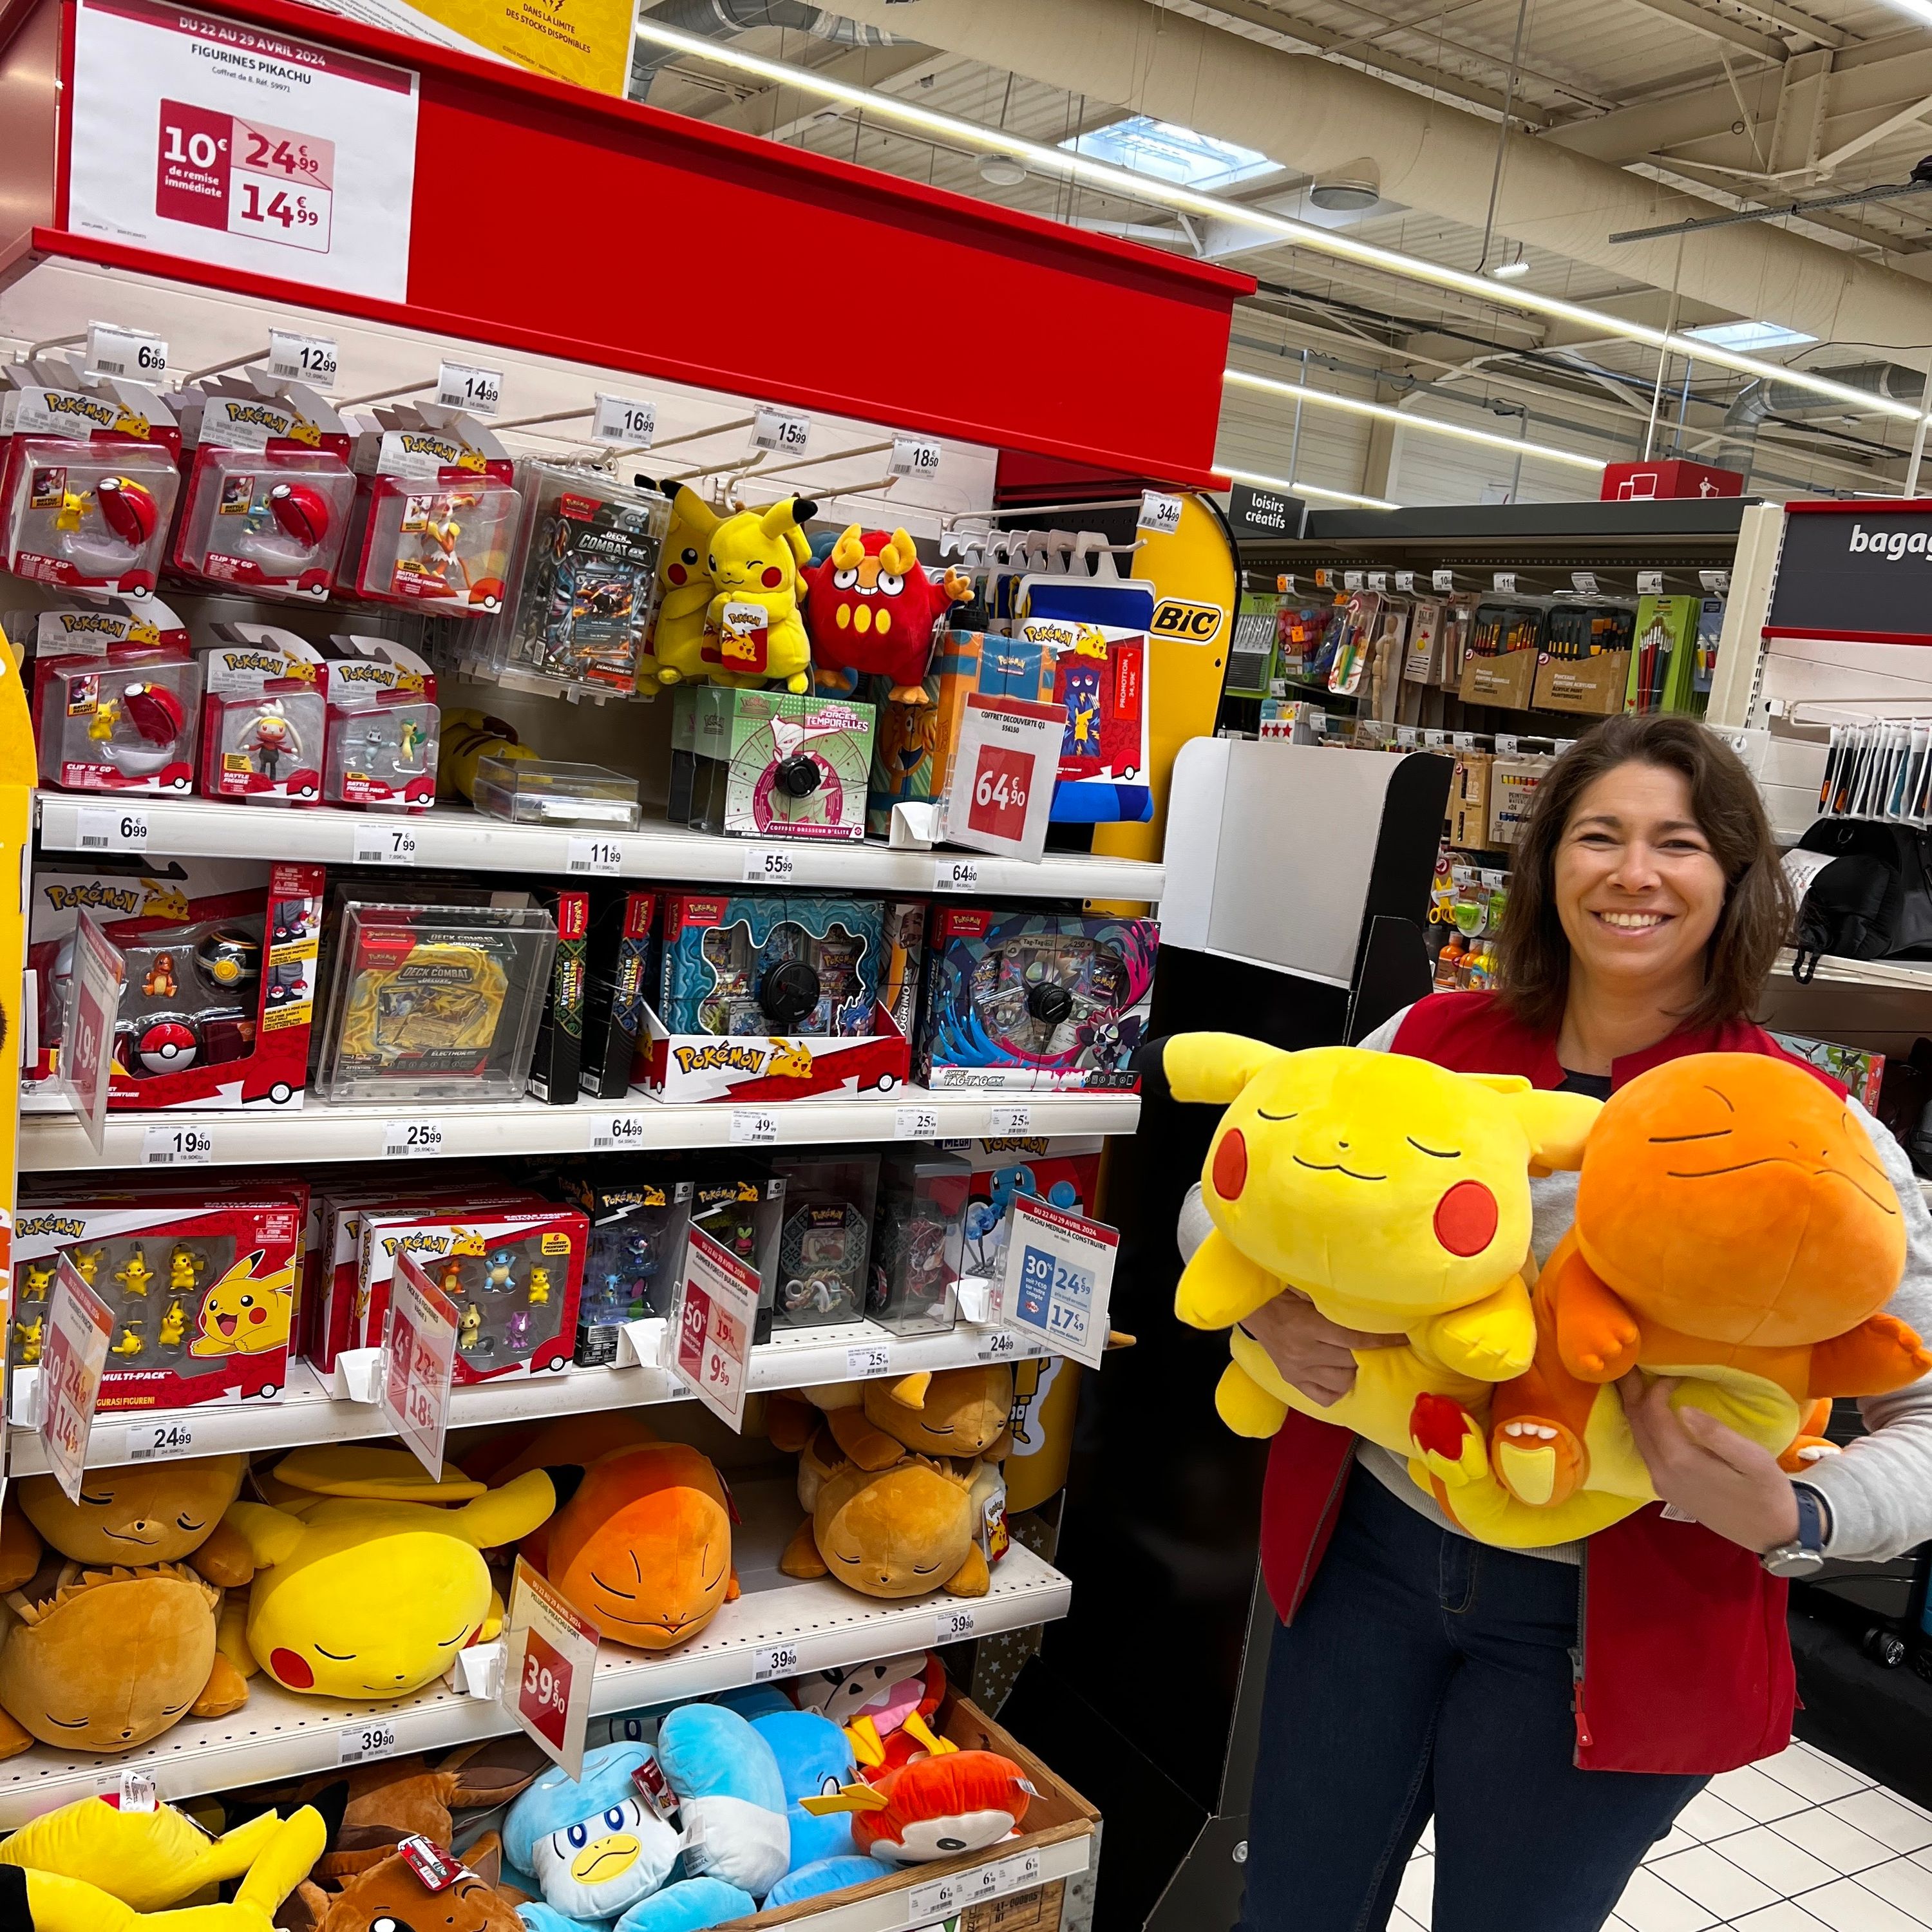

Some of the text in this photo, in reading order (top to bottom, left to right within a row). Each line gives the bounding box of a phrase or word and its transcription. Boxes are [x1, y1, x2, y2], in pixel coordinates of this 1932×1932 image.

[523, 3, 576, 34] DANS LA LIMITE
[506, 8, 591, 53] DES STOCKS DISPONIBLES
[180, 17, 326, 66] DU 22 AU 29 AVRIL 2024
[191, 44, 311, 84] FIGURINES PIKACHU
[212, 66, 236, 79] Coffret
[169, 166, 220, 185] de remise
[165, 175, 222, 198] immédiate
[1252, 493, 1284, 513] loisirs
[1245, 509, 1285, 529] créatifs
[579, 534, 628, 556] COMBAT
[605, 531, 628, 542] DECK
[1849, 524, 1932, 561] baga
[21, 554, 41, 564] CLIP
[210, 554, 229, 564] CLIP
[1120, 659, 1128, 708] PROMOTION
[806, 715, 868, 732] TEMPORELLES
[820, 710, 858, 722] FORCES
[981, 711, 1002, 724] COFFRET
[1003, 714, 1037, 728] DECOUVERTE
[402, 967, 468, 978] DECK COMBAT
[944, 1075, 988, 1086] TAG-TAG
[944, 1138, 970, 1149] MEGA
[1034, 1207, 1042, 1215] DU
[1065, 1219, 1081, 1231] AVRIL
[1082, 1226, 1097, 1236] 2024
[1023, 1213, 1045, 1227] PIKACHU
[1045, 1222, 1066, 1235] MEDIUM
[1072, 1233, 1107, 1251] CONSTRUIRE
[1025, 1255, 1053, 1279] 30%
[123, 1396, 155, 1406] FIGUREN!
[531, 1591, 549, 1611] PELUCHE
[548, 1608, 567, 1630] PIKACHU
[567, 1625, 580, 1641] DORT
[556, 1602, 569, 1619] AVRIL
[569, 1614, 582, 1629] 2024
